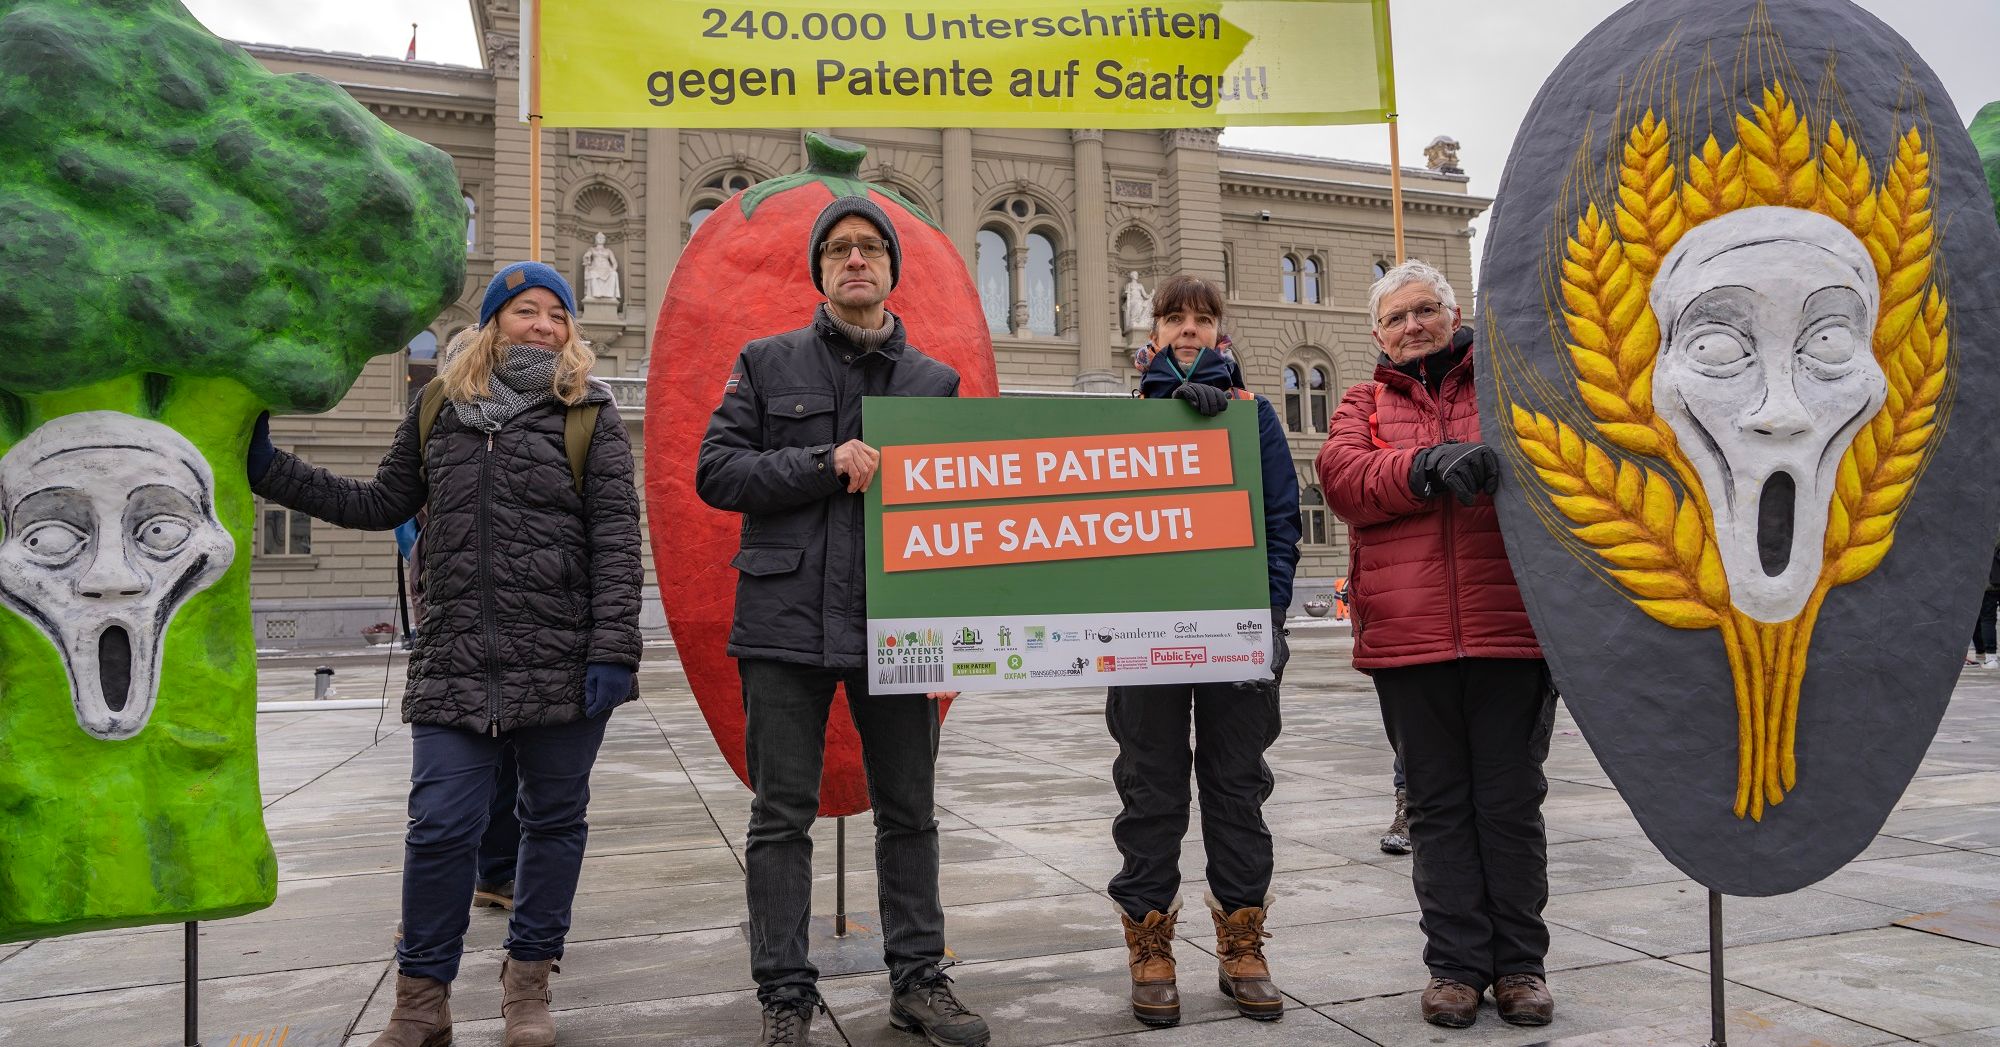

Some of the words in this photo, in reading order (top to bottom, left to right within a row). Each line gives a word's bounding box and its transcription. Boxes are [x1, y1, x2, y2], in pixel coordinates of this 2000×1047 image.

[702, 8, 887, 40] 240.000
[905, 7, 1220, 40] Unterschriften
[646, 67, 796, 107] gegen
[816, 59, 993, 97] Patente
[1009, 60, 1079, 98] auf
[1093, 59, 1267, 108] Saatgut!
[904, 454, 1022, 491] KEINE
[1036, 443, 1201, 484] PATENTE
[903, 521, 983, 559] AUF
[999, 508, 1194, 552] SAATGUT!
[878, 648, 893, 656] NO
[898, 647, 944, 656] PATENTS
[878, 657, 895, 665] ON
[902, 655, 944, 664] SEEDS!
[1154, 651, 1183, 662] Public
[1185, 650, 1203, 667] Eye
[1211, 654, 1250, 663] SWISSAID
